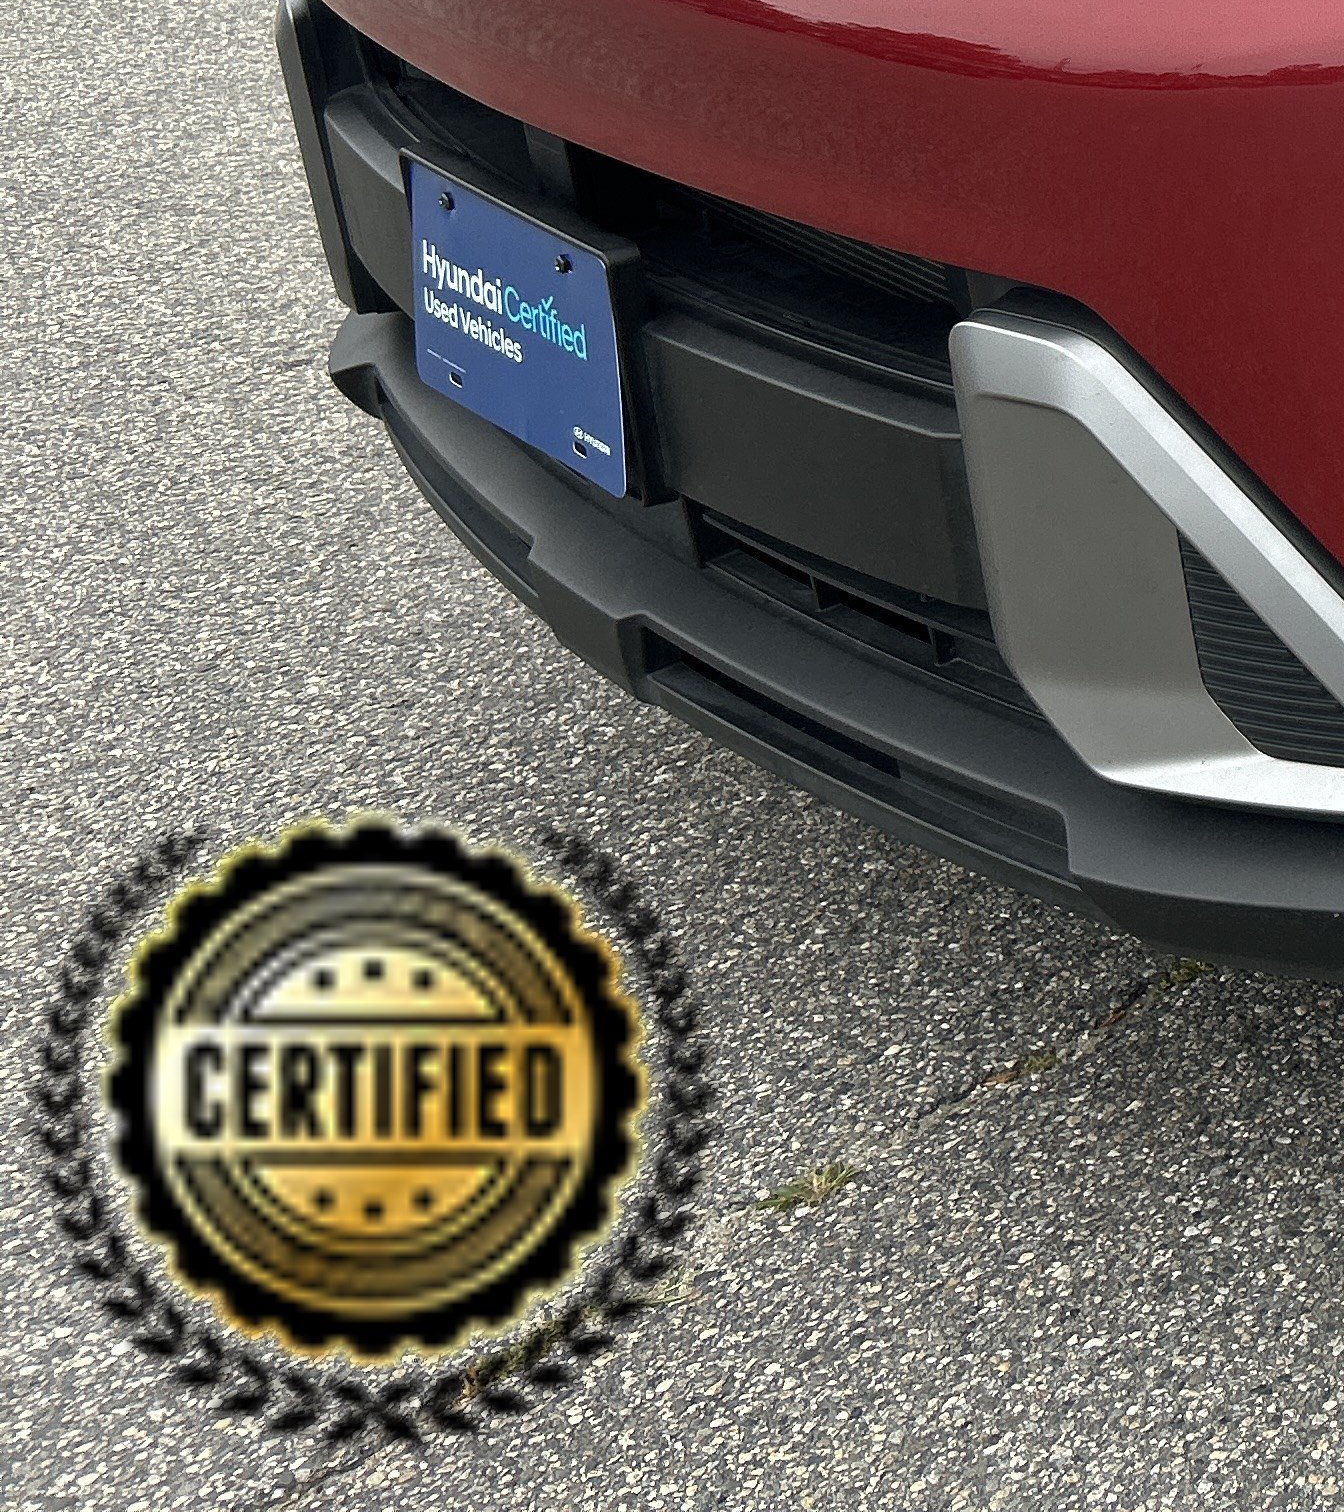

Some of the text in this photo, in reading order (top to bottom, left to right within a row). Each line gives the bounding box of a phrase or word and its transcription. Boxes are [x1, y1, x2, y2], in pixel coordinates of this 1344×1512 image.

[422, 239, 588, 361] Hyundai Certified
[423, 287, 459, 329] Used
[459, 306, 523, 363] Vehicles
